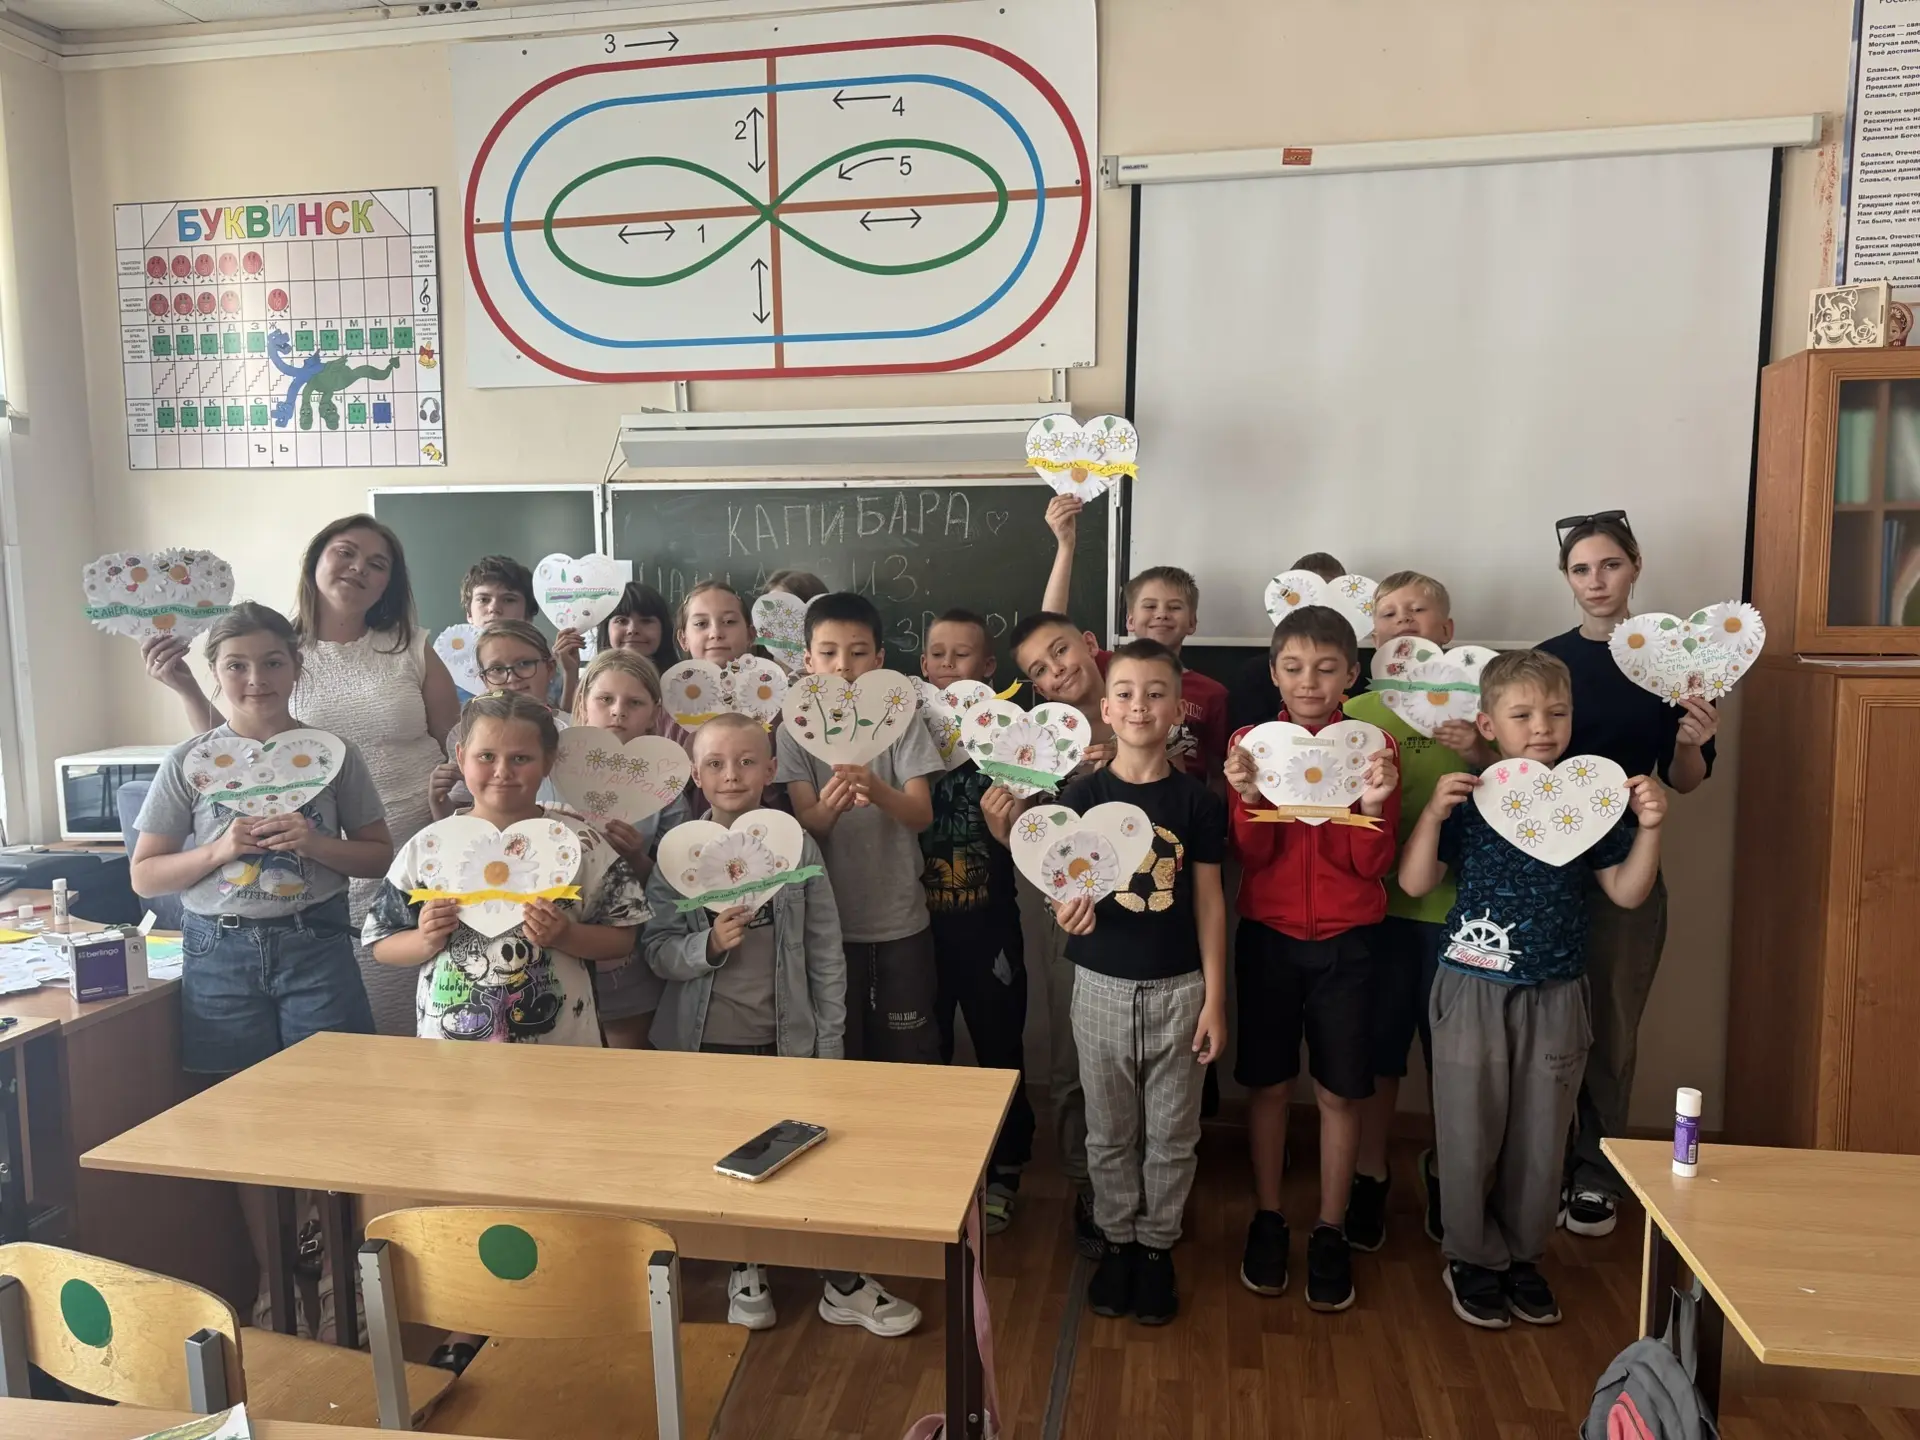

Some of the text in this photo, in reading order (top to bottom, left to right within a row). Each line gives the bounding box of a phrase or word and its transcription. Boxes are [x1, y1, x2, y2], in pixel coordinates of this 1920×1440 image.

[604, 34, 616, 53] 3
[1865, 83, 1902, 91] Предками
[892, 98, 905, 117] 4
[735, 121, 747, 140] 2
[899, 156, 912, 176] 5
[177, 199, 375, 242] БУКВИНСК
[698, 225, 705, 244] 1
[227, 324, 235, 332] Д
[269, 322, 278, 330] Ж
[300, 321, 307, 329] Р
[325, 320, 333, 328] Л
[398, 316, 406, 325] Й
[335, 395, 342, 403] Ч
[377, 394, 387, 402] Ц
[254, 444, 289, 453] Ъ Ь
[726, 491, 970, 557] КАПИБАРА
[86, 948, 119, 958] berlingo
[1456, 948, 1498, 968] Voyager
